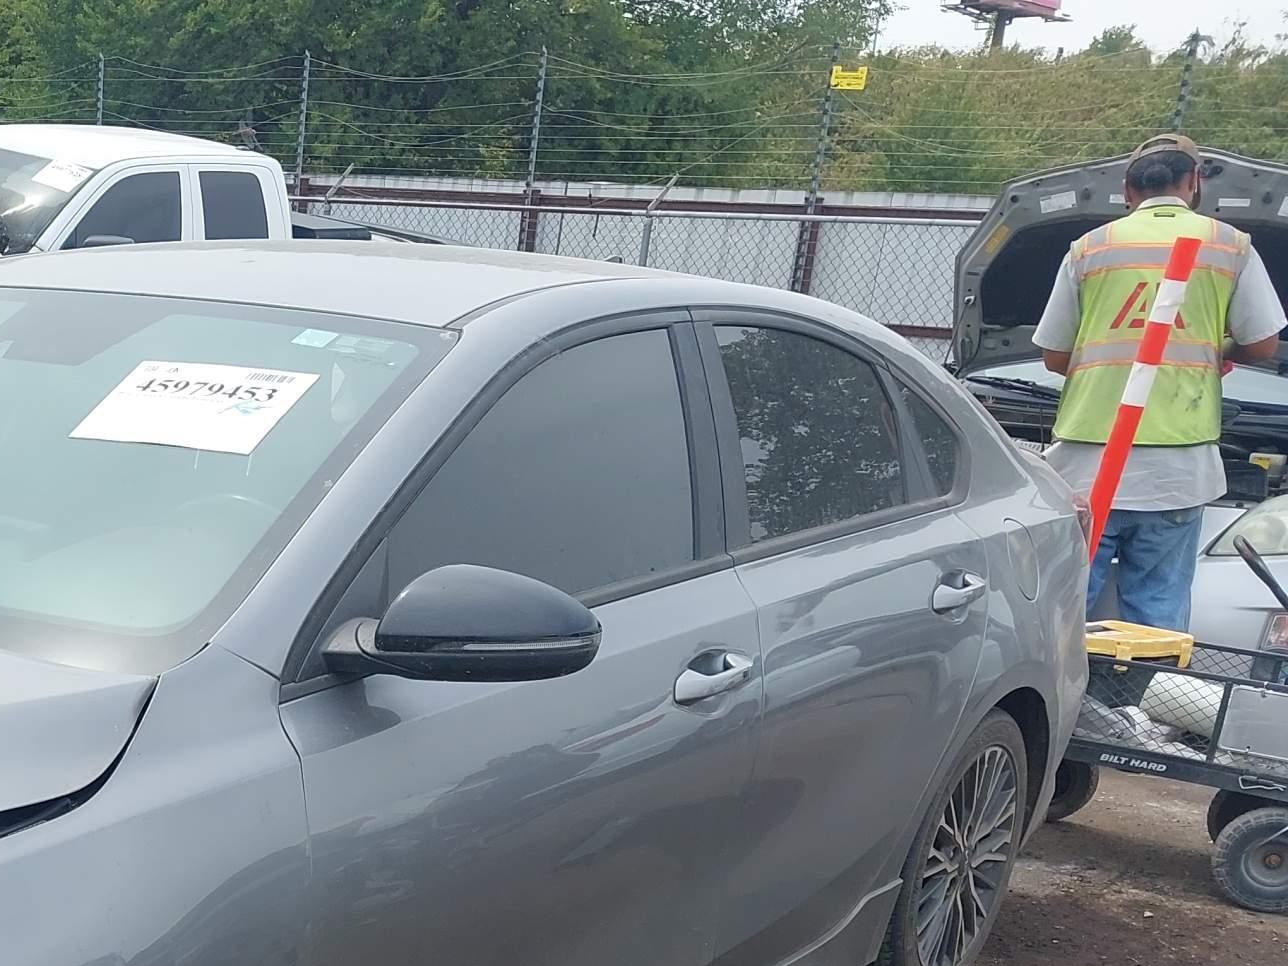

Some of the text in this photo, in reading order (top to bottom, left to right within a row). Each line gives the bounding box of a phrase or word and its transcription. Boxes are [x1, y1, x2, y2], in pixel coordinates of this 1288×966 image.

[136, 378, 278, 402] 45979453
[1100, 753, 1167, 772] BILT HARD
